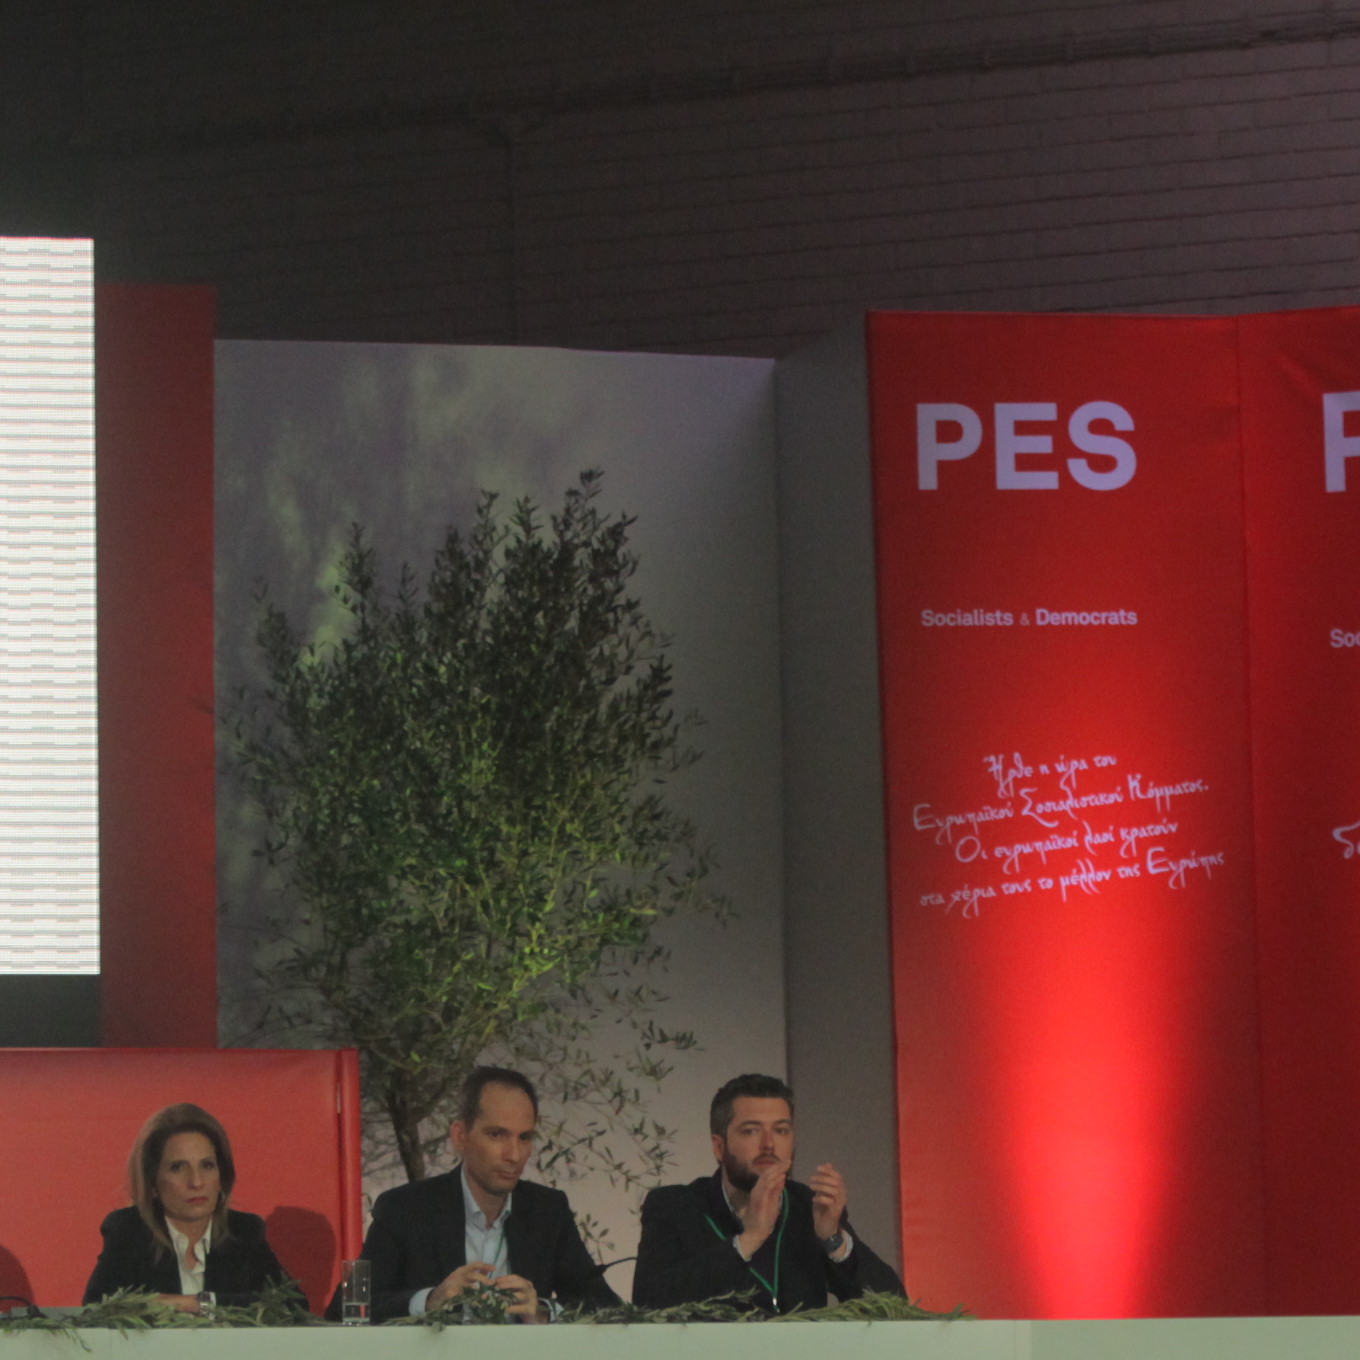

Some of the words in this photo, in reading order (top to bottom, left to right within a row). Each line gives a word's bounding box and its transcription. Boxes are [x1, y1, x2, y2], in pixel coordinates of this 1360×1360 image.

[916, 400, 1138, 492] PES
[920, 607, 1014, 627] Socialists
[1019, 613, 1031, 627] &
[1035, 607, 1139, 627] Democrats
